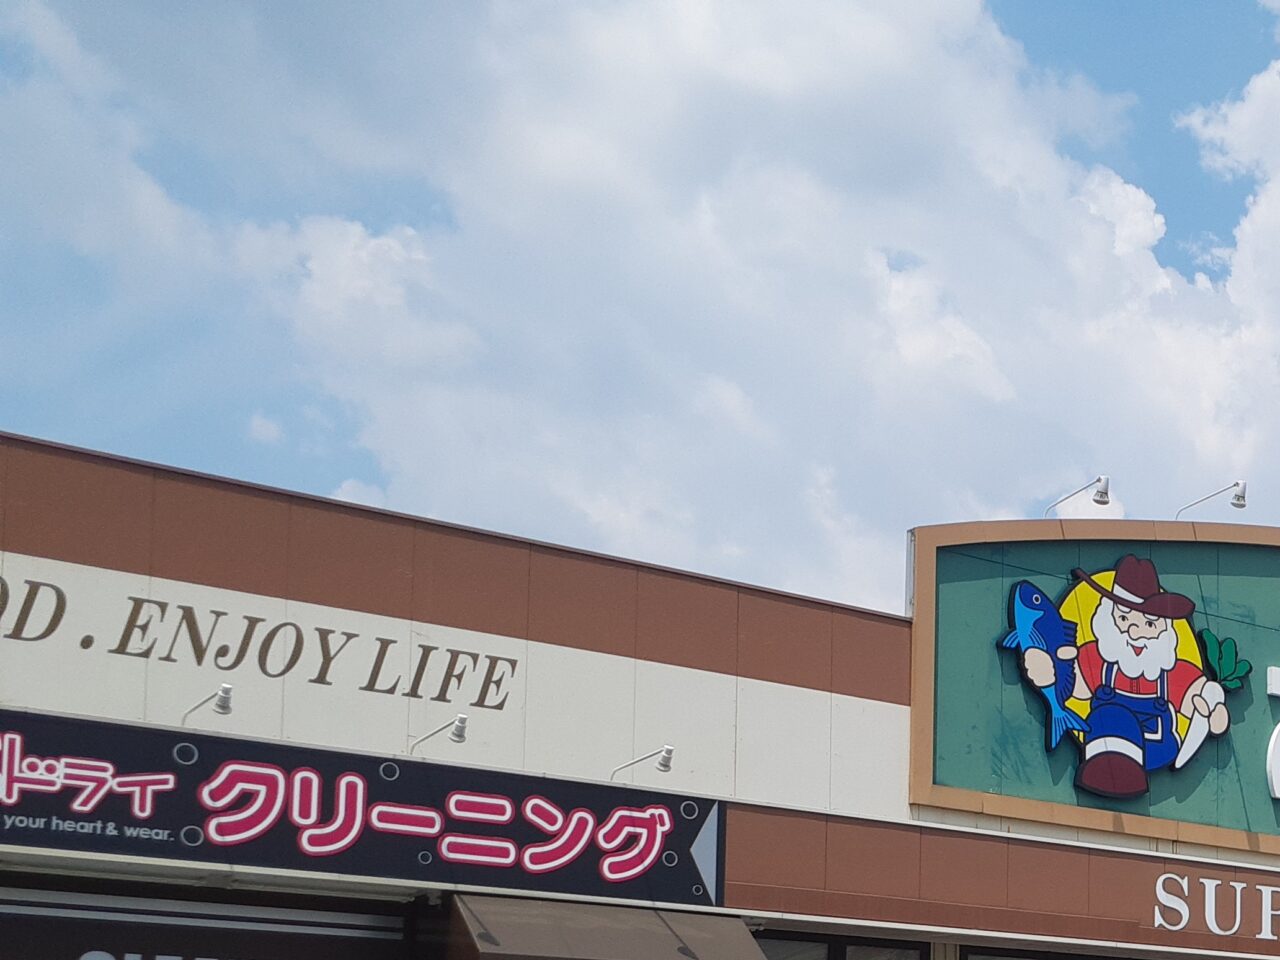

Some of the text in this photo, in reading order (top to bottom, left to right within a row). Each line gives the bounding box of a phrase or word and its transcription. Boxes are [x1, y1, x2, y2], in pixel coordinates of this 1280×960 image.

[107, 595, 359, 687] ENJOY
[359, 637, 518, 711] LIFE
[0, 731, 672, 883] ドライ クリーニング
[3, 814, 175, 841] your heart & wear.
